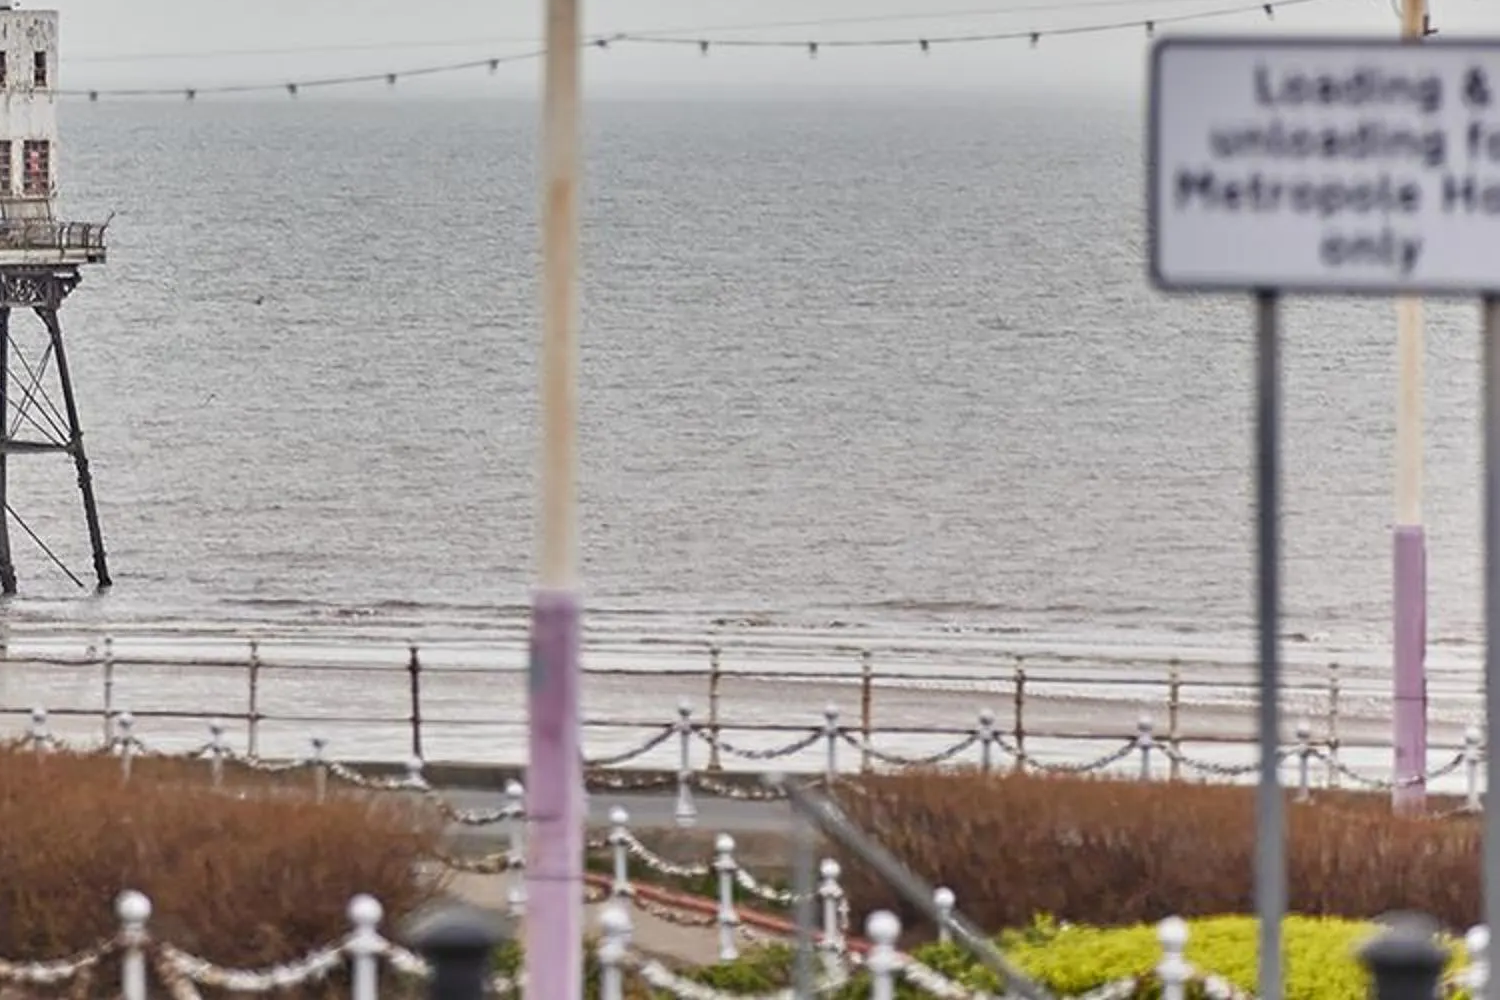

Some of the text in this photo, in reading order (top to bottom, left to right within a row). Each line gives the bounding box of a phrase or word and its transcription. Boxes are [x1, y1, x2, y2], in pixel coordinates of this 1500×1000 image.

[1254, 63, 1490, 113] Loading &
[1209, 120, 1445, 167] unloading
[1174, 170, 1421, 218] Metropole
[1320, 224, 1424, 275] only
